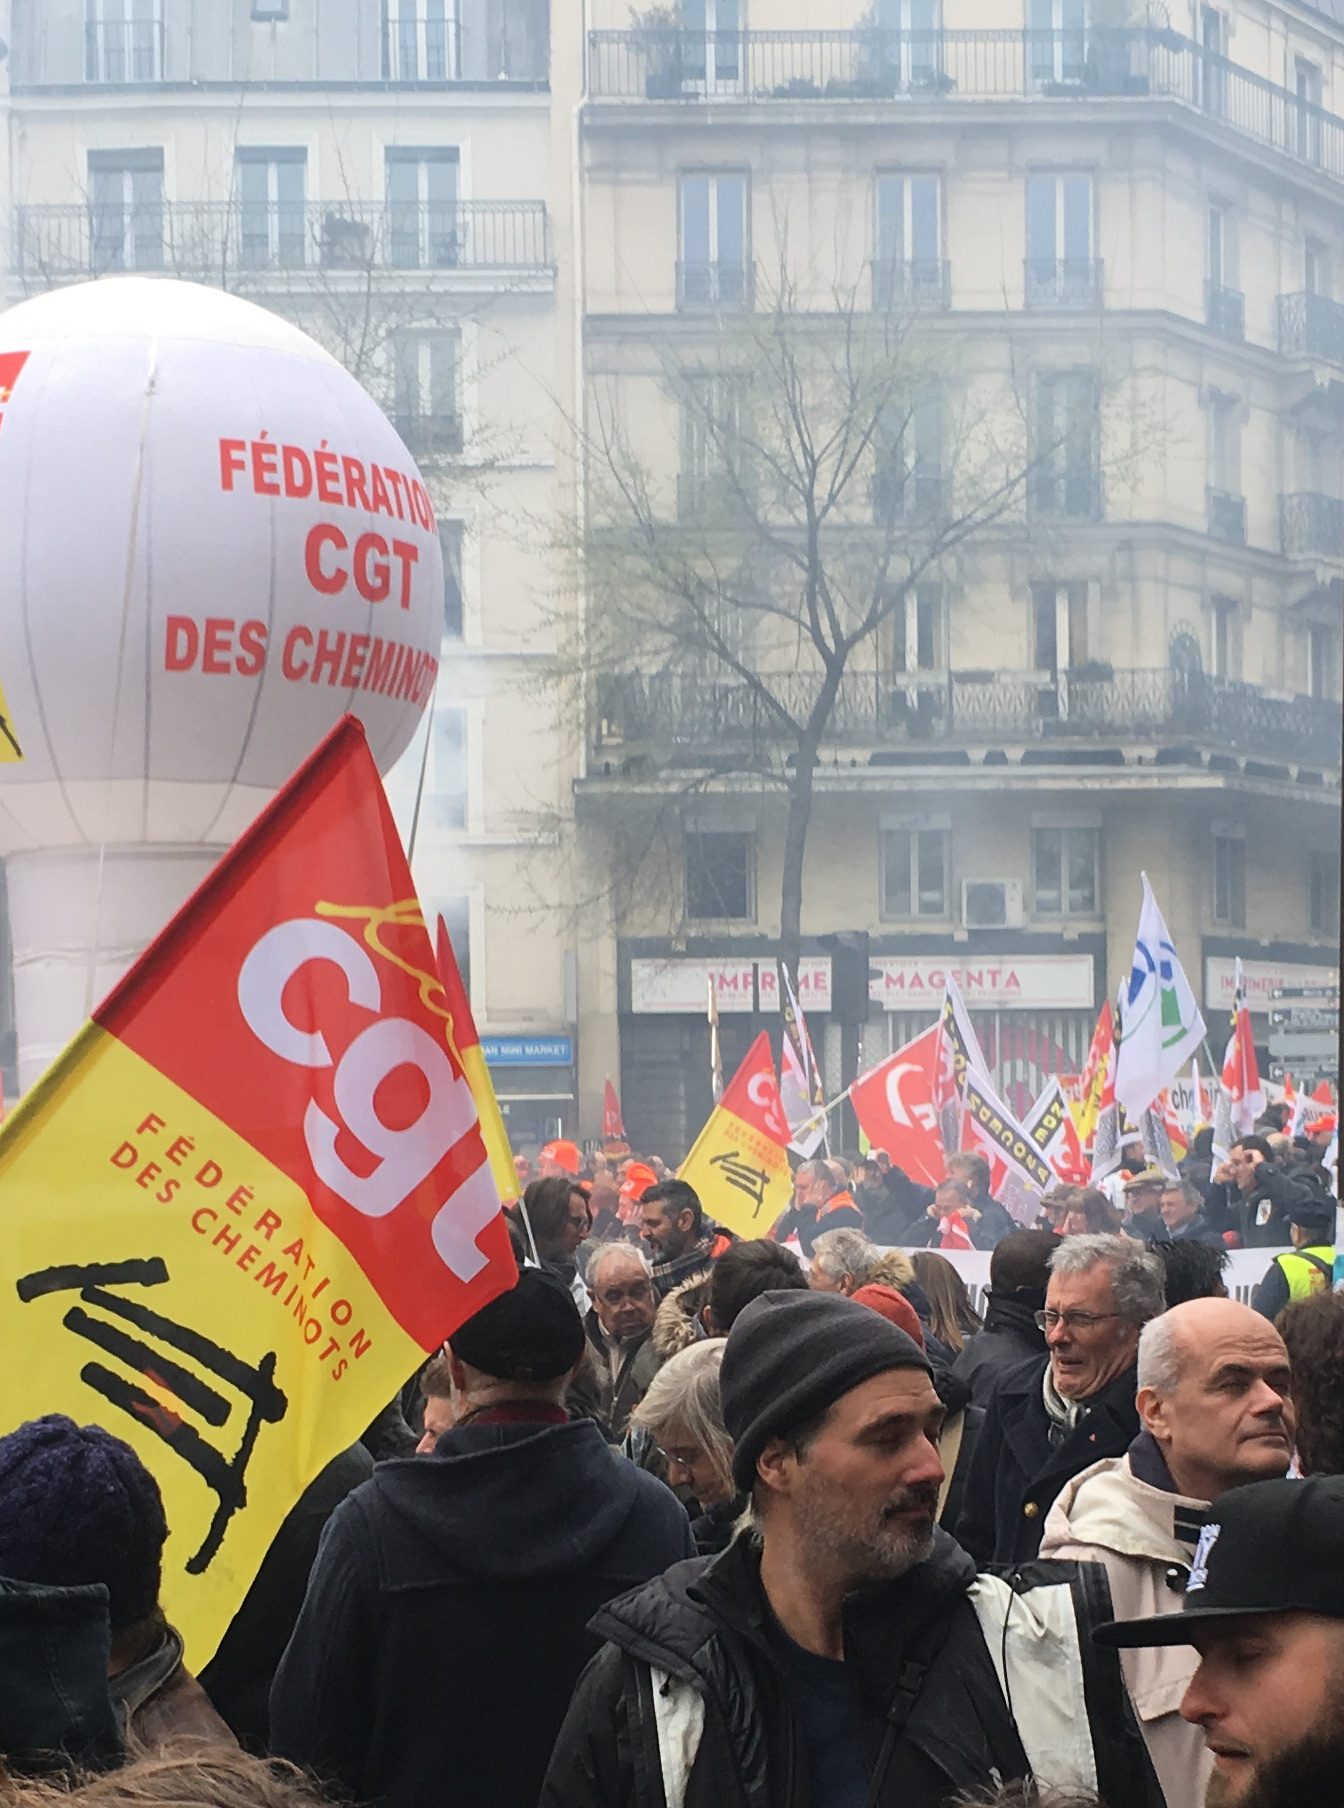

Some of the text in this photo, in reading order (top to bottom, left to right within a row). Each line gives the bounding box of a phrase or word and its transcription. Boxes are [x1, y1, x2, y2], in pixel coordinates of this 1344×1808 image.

[304, 522, 419, 610] CGT
[164, 614, 267, 676] DES
[884, 969, 1021, 990] MAGENTA
[109, 1141, 350, 1382] DES CHEMINOTS
[136, 1112, 373, 1359] FÉDÉRATION
